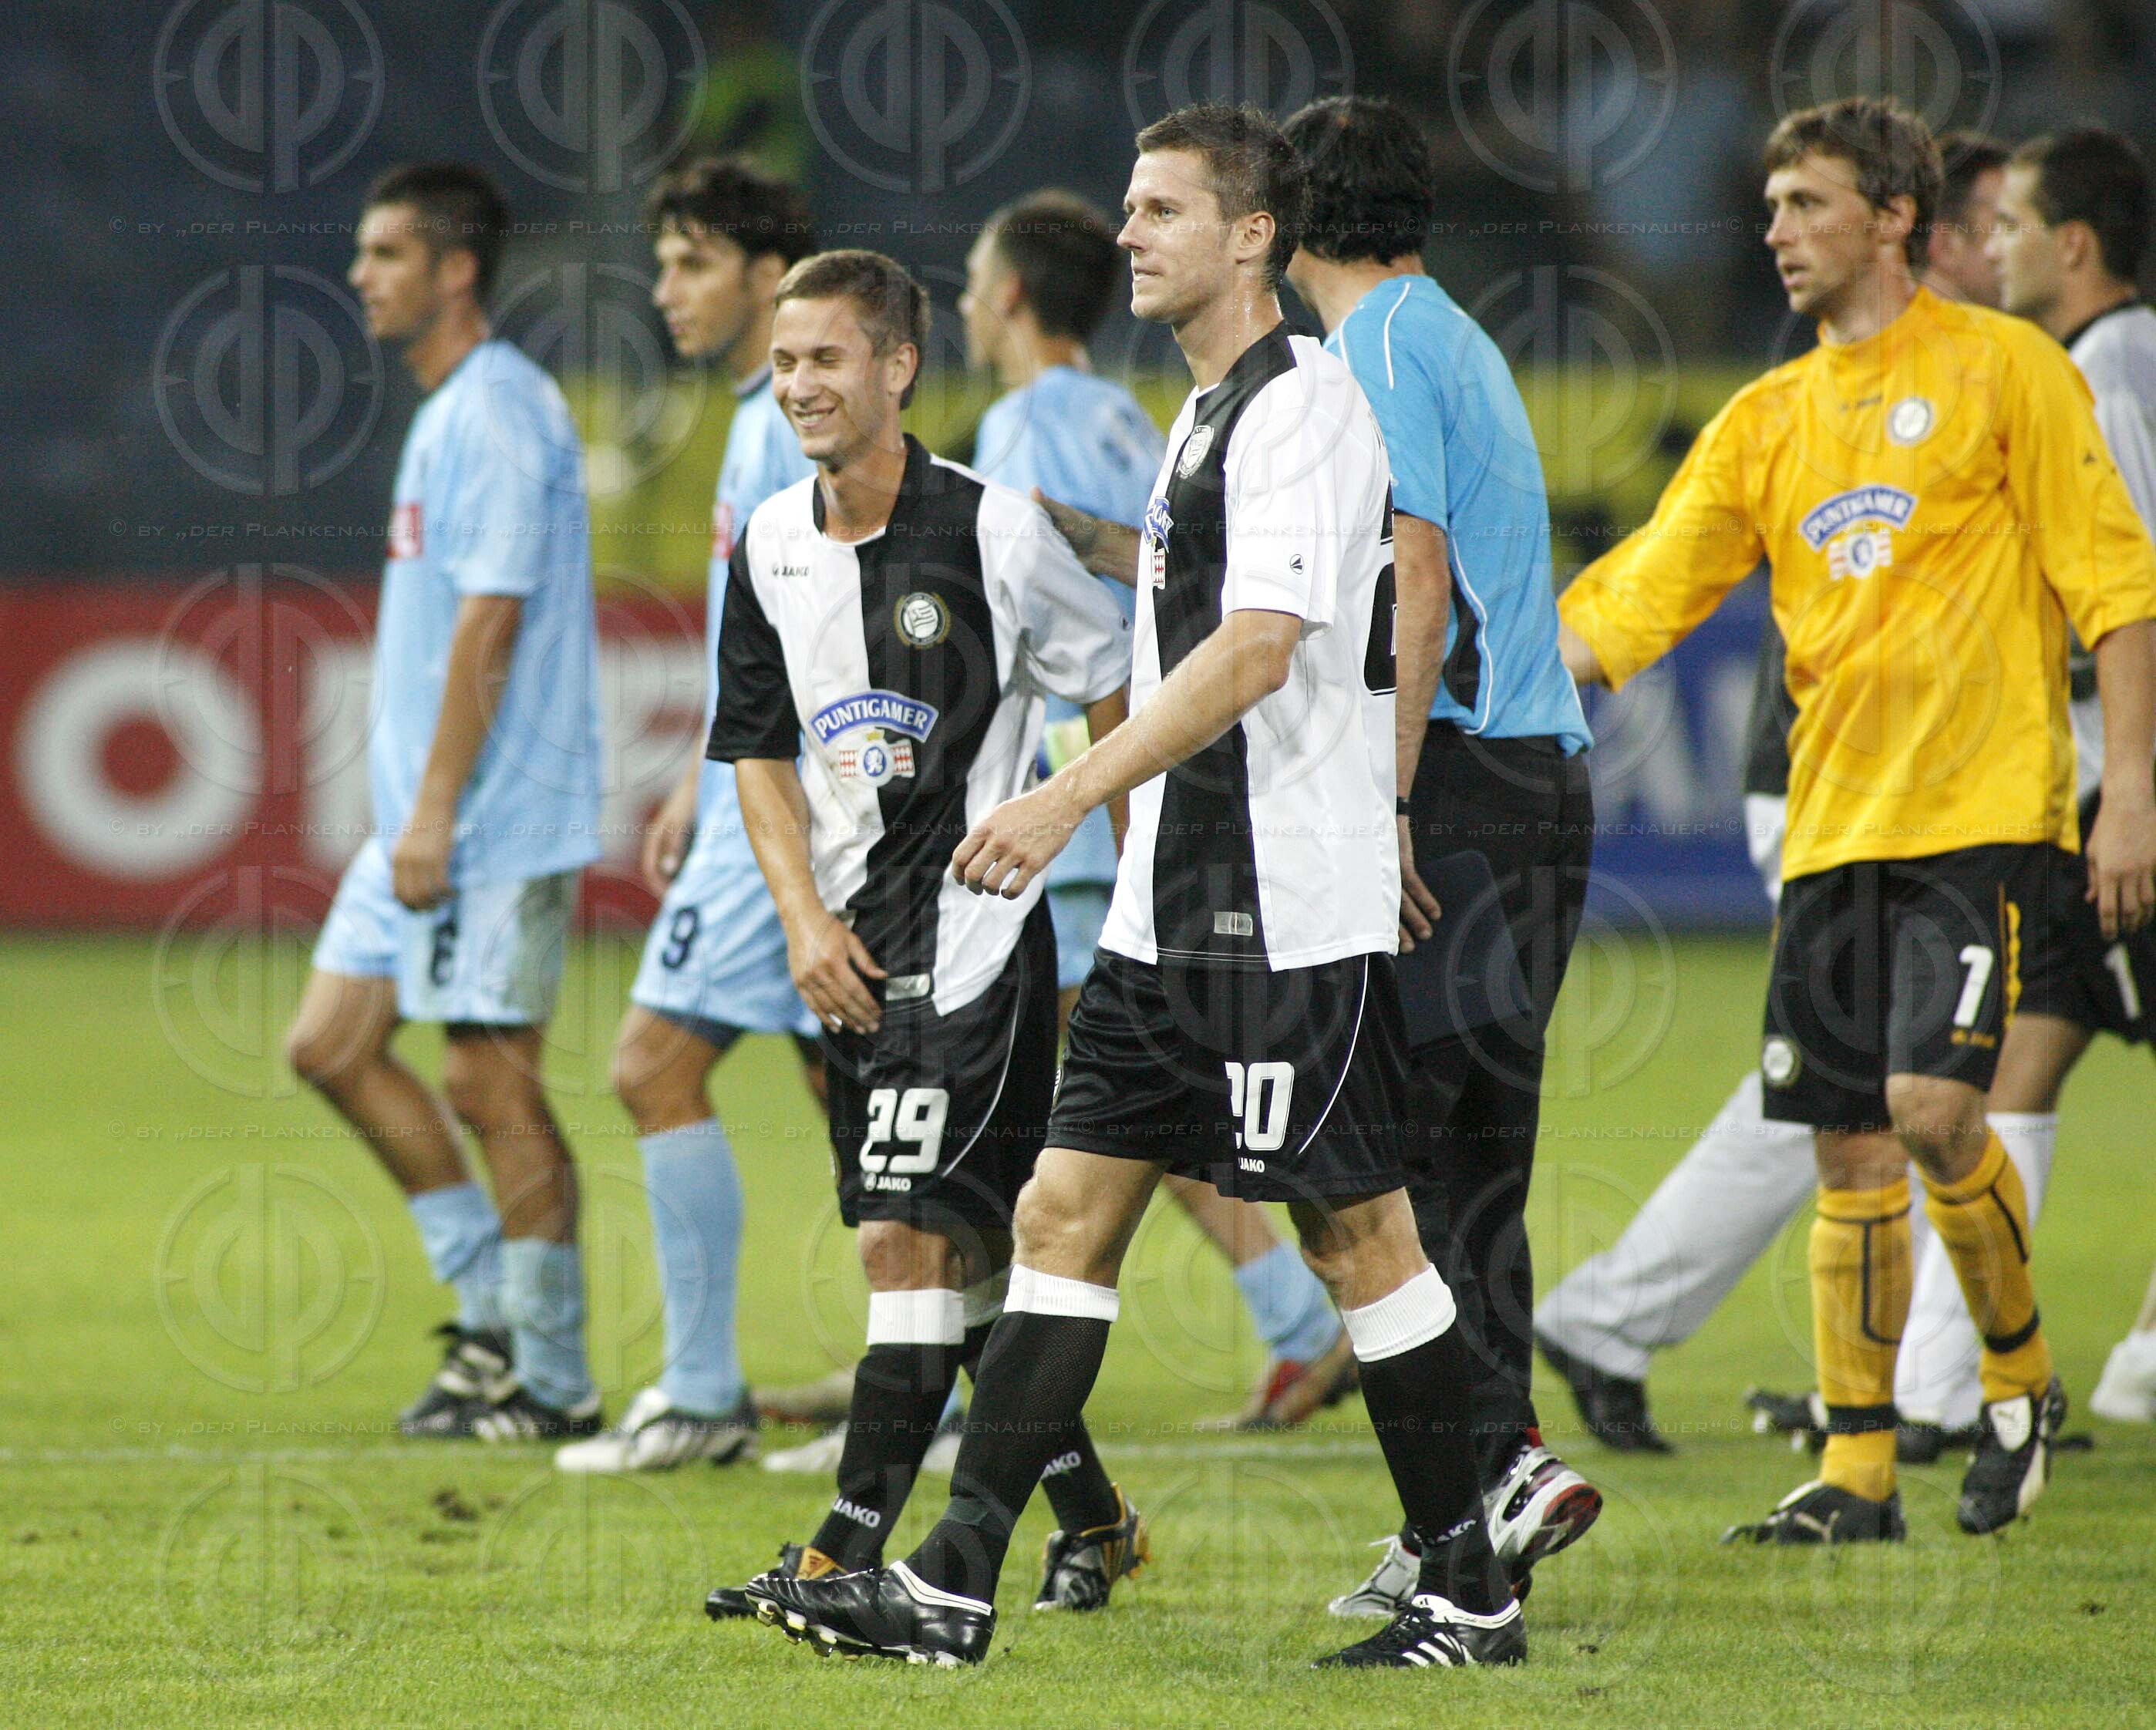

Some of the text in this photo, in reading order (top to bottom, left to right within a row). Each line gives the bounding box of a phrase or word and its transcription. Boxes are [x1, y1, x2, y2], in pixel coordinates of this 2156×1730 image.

[814, 698, 928, 738] PUNTIGAMER
[662, 907, 699, 970] 9
[859, 1088, 950, 1173] 29
[877, 1176, 912, 1192] JAKO
[1043, 1451, 1081, 1478] AKO
